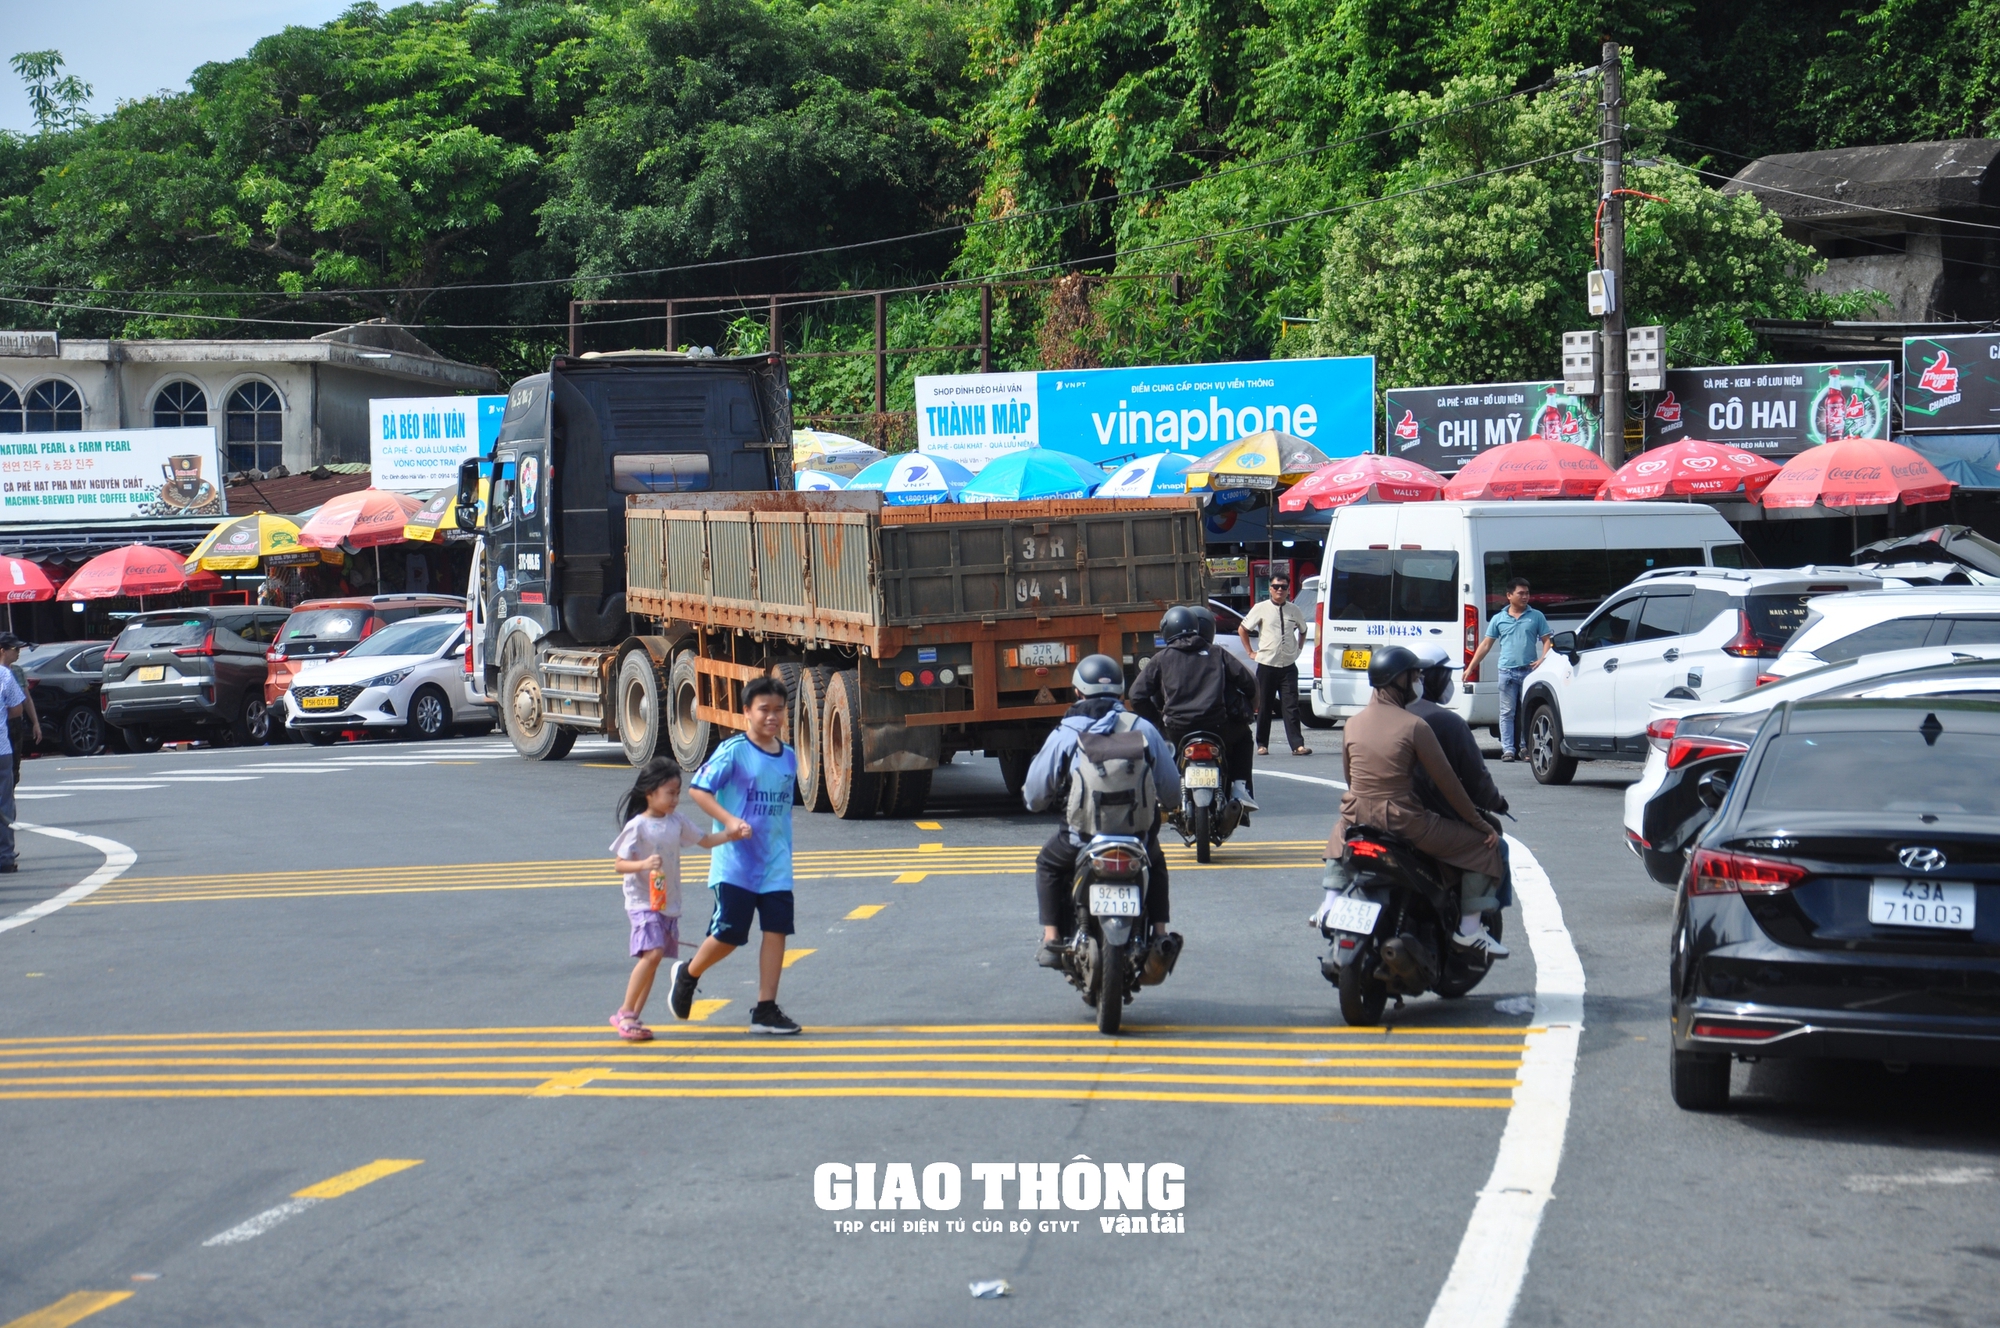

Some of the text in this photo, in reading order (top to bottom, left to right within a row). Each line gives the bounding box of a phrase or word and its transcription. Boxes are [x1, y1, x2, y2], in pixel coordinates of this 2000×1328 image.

[934, 387, 954, 396] SHOP
[975, 384, 991, 394] ĐÈO
[1007, 383, 1022, 392] VÂN
[1064, 381, 1087, 389] VNPT
[1131, 381, 1150, 393] ĐIỂM
[1152, 383, 1174, 393] CUNG
[1176, 380, 1192, 392] CẤP
[1193, 381, 1213, 391] DỊCH
[1214, 381, 1225, 391] VỤ
[1247, 377, 1274, 388] THÔNG
[1704, 377, 1714, 389] CÀ
[1715, 376, 1729, 388] PHÊ
[1735, 377, 1751, 388] KEM
[1784, 376, 1803, 388] NIỆM
[1437, 396, 1446, 408] CÀ
[1447, 395, 1460, 407] PHÊ
[1465, 395, 1478, 406] KEM
[1507, 394, 1524, 405] NIỆM
[1929, 393, 1961, 412] CHARGED
[926, 397, 1031, 440] THÀNH MẬP
[1708, 396, 1743, 431] CÔ
[1751, 400, 1796, 429] HAI
[382, 406, 465, 440] BÀ BÉO HẢI VÂN
[1091, 396, 1318, 450] vinaphone
[1661, 420, 1683, 434] CHARGED
[1438, 413, 1523, 451] CHỊ MỸ
[0, 440, 131, 455] NATURAL PEARL & FARM PEARL
[383, 445, 394, 454] CÀ
[394, 445, 408, 454] PHÊ
[415, 445, 432, 454] QUÀ
[448, 443, 467, 454] NIỆM
[1401, 438, 1421, 451] CHARGED
[2, 458, 94, 472] 천연 진주 & 농장 진주
[416, 459, 437, 468] NGỌC
[438, 459, 456, 467] TRAI
[16, 479, 31, 492] PHÊ
[52, 480, 68, 490] PHA
[70, 478, 87, 490] MÁY
[89, 477, 120, 489] NGUYÊN
[122, 475, 143, 488] CHẤT
[1626, 485, 1652, 494] WALL'S
[1691, 480, 1723, 489] WALL'S
[4, 492, 155, 506] MACHINE-BREWED PURE COFFEE BEANS
[1026, 489, 1084, 502] vinaphone
[1393, 488, 1421, 497] WALL'S
[1033, 644, 1052, 655] 37R
[1350, 651, 1363, 660] 43B
[1025, 655, 1060, 667] 046.14
[1344, 660, 1367, 668] 044.28
[753, 803, 768, 816] FLY
[1745, 839, 1800, 849] ACCENT
[1098, 887, 1131, 900] 92-G1
[1902, 881, 1945, 902] 43A
[1093, 900, 1137, 914] 221.87
[1339, 900, 1373, 918] 74-E1
[1884, 902, 1963, 924] 710.03
[1331, 912, 1373, 932] 092.58
